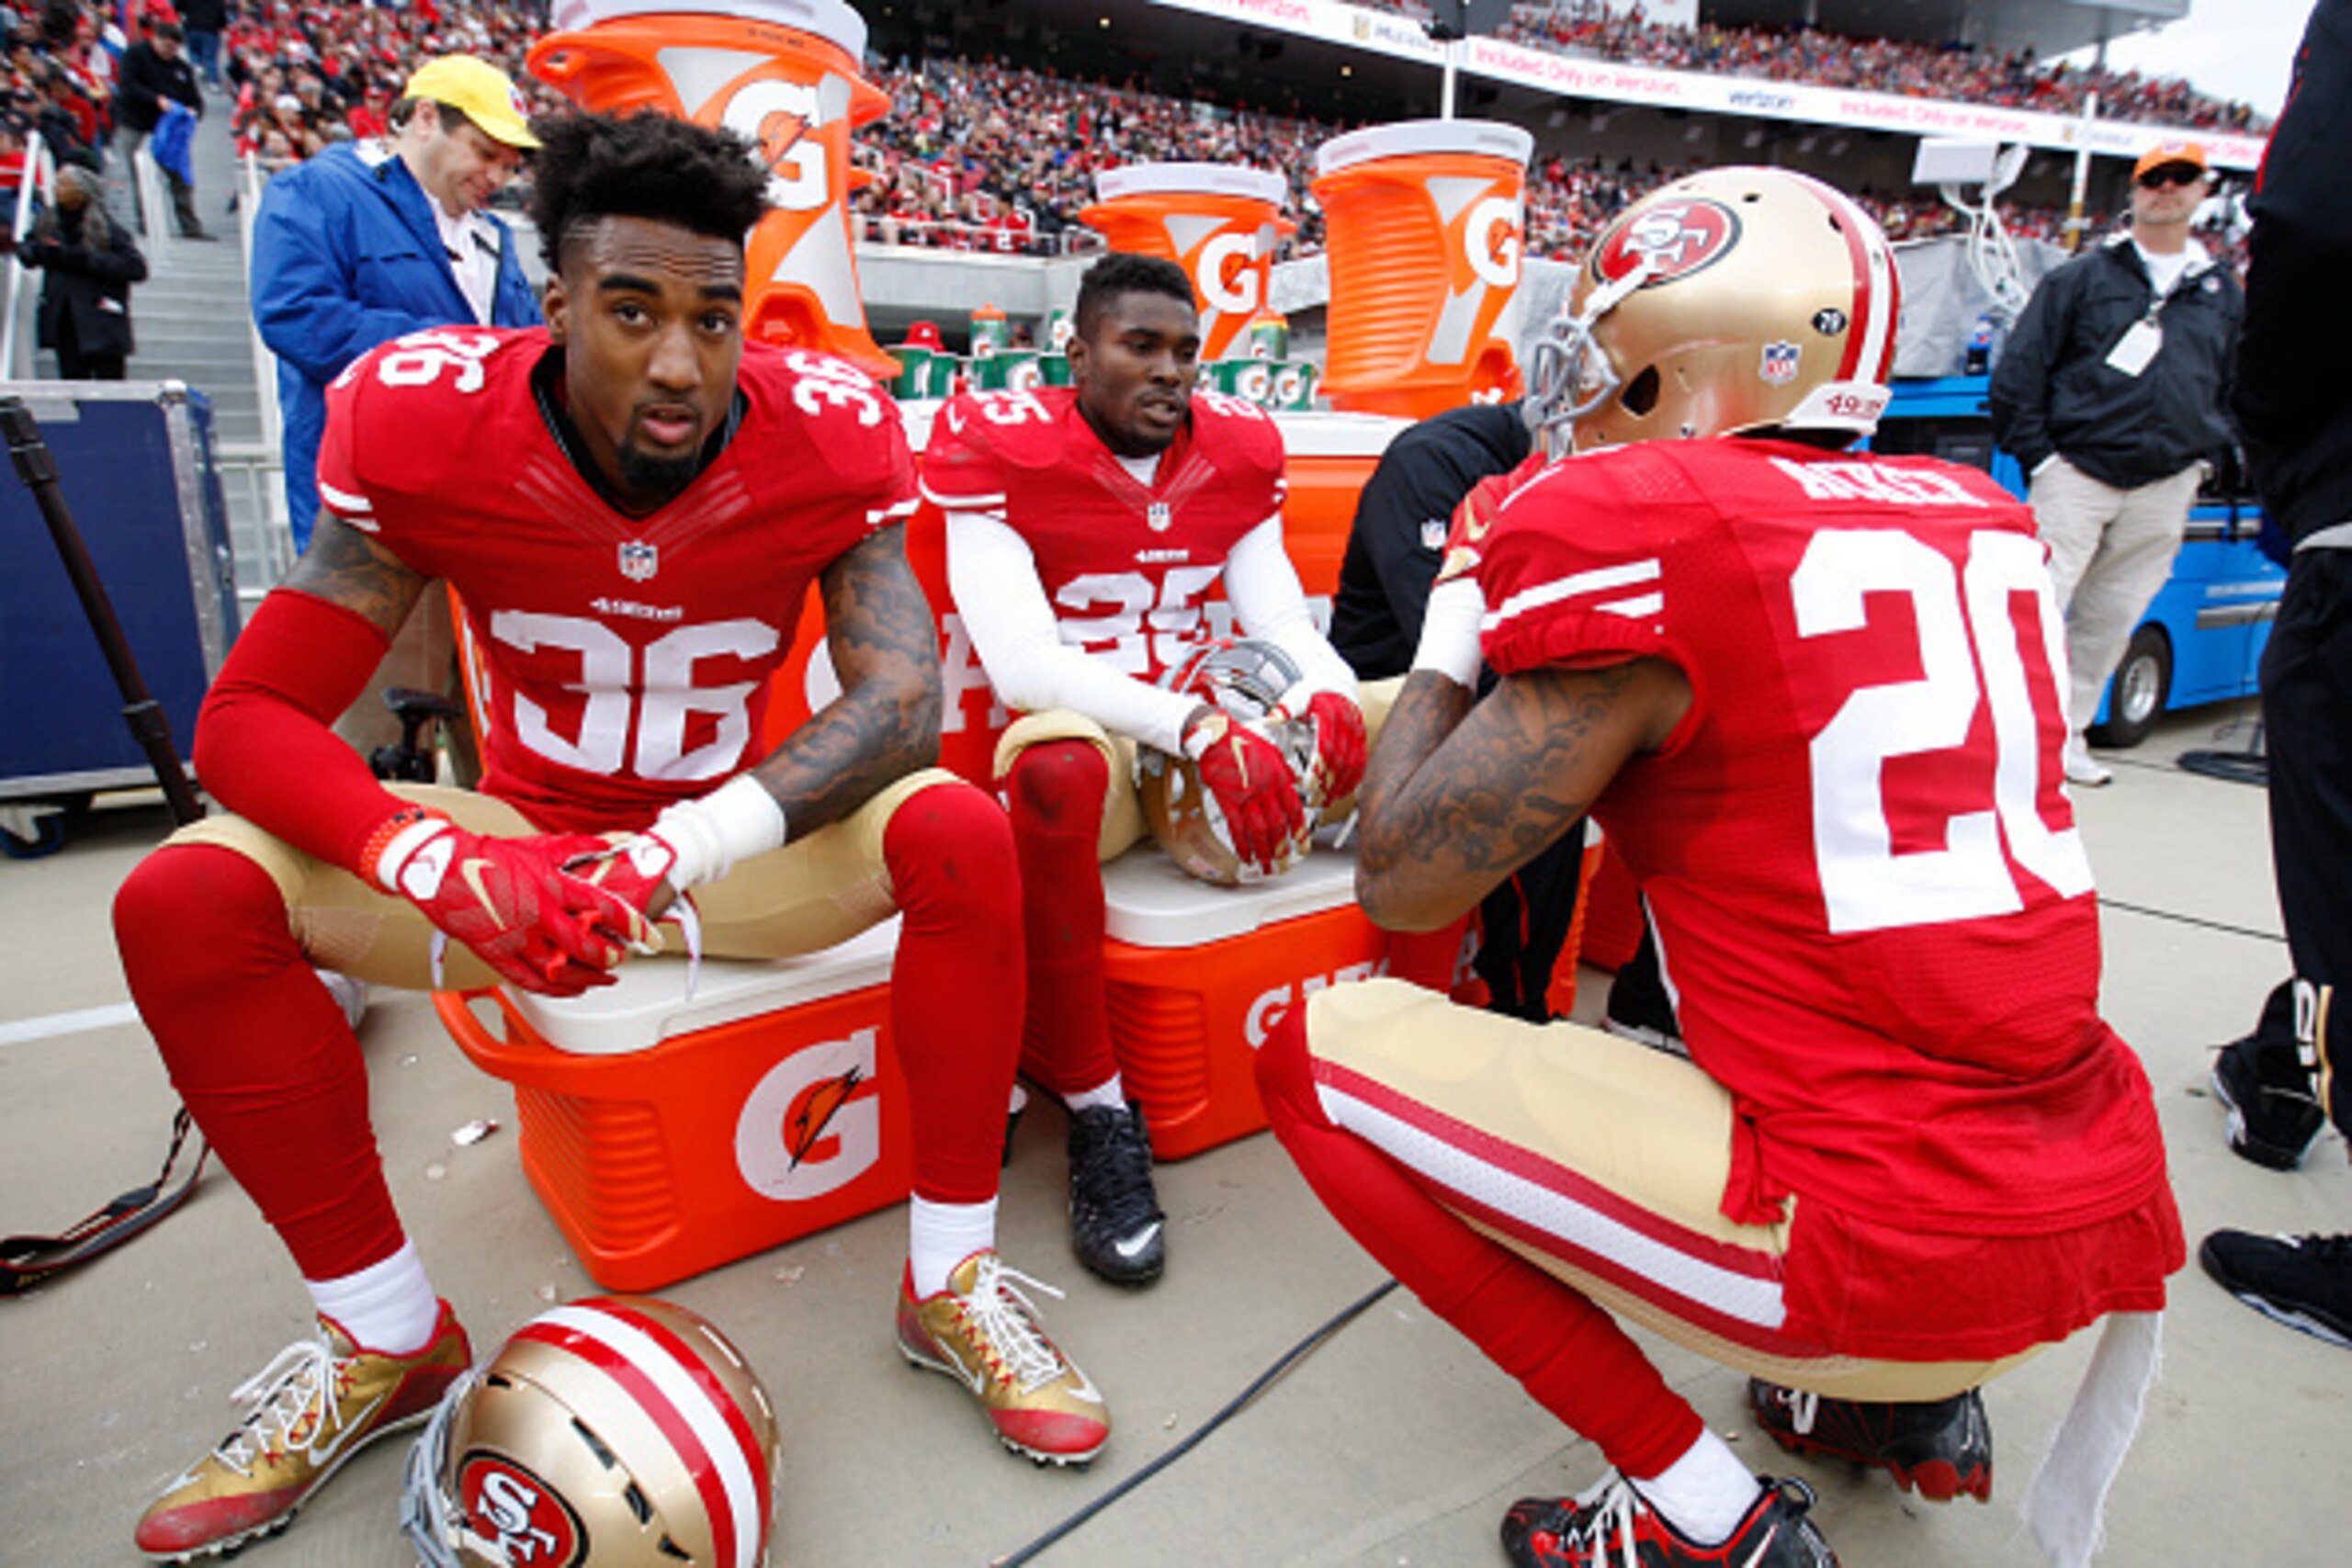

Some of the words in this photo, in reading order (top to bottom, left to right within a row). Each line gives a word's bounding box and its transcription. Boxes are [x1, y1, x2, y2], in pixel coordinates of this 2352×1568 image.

[1198, 233, 1258, 313] G
[1464, 197, 1521, 287] G
[491, 610, 781, 781] 36
[1789, 527, 2098, 936] 20
[735, 1025, 881, 1201] G
